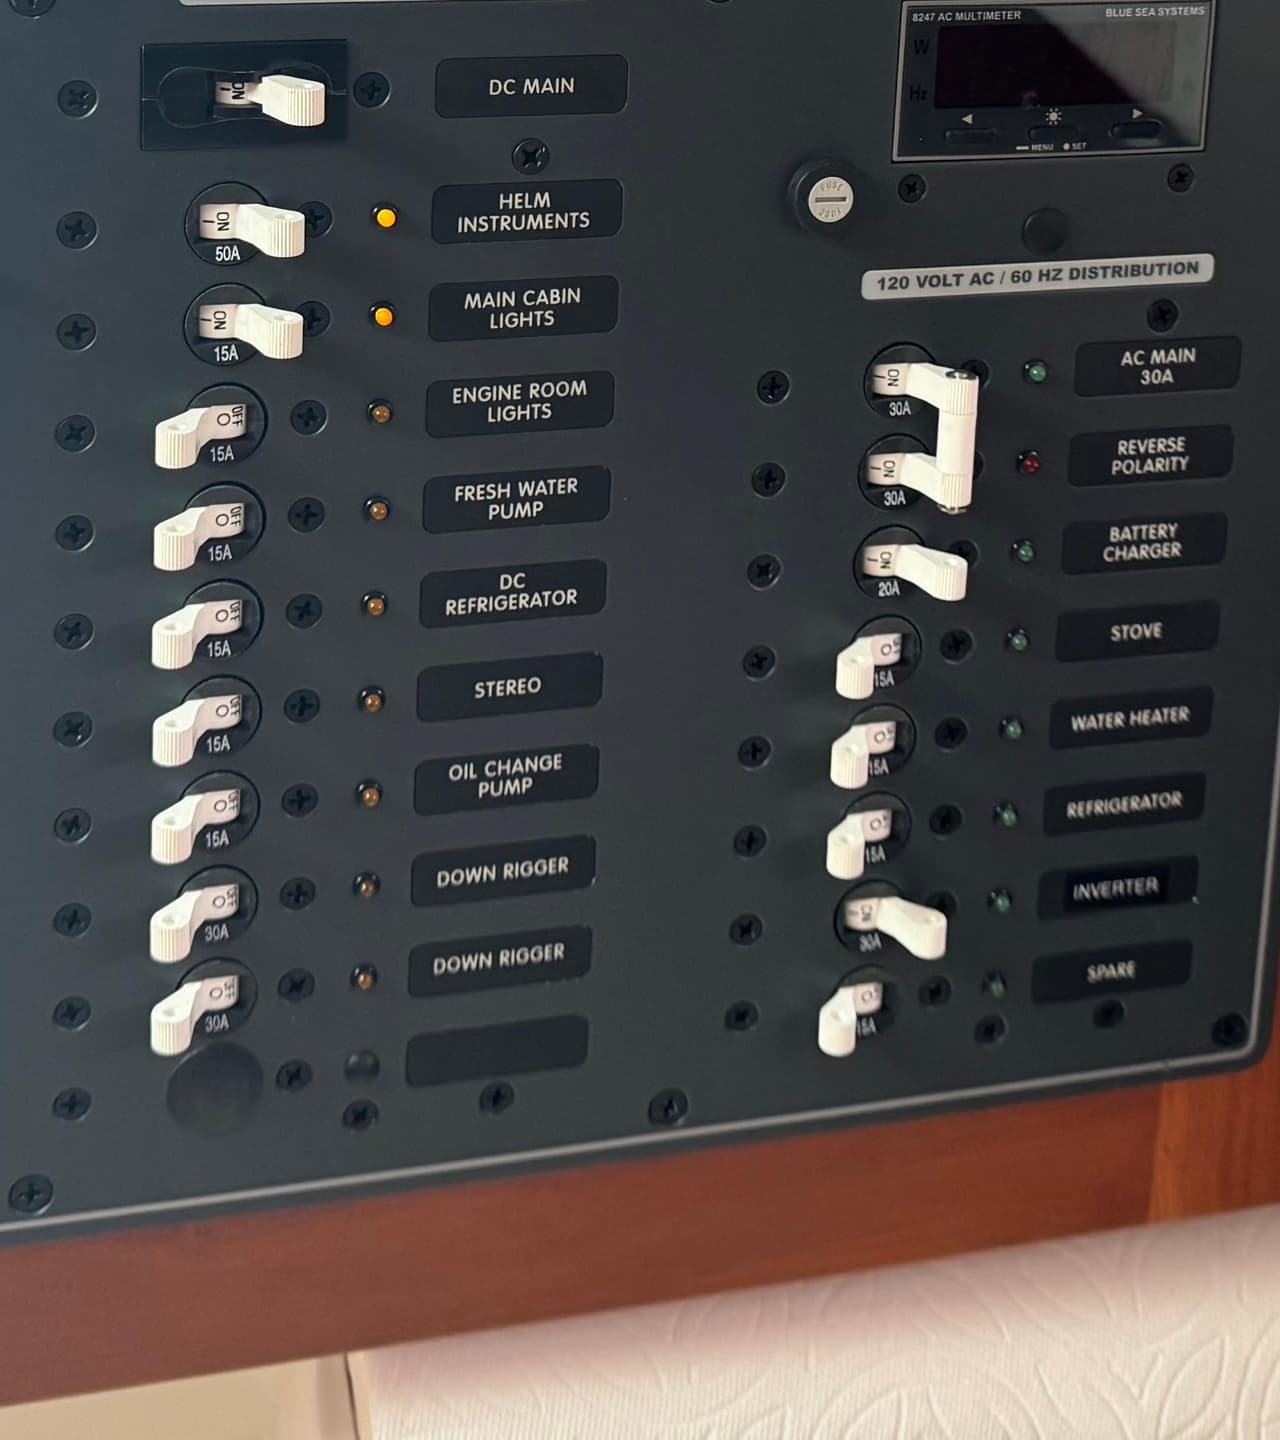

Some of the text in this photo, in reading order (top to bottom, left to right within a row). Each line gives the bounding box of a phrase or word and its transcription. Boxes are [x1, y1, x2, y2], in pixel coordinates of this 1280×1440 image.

[912, 10, 1021, 23] 8247 AC MULTIMETER
[1106, 7, 1205, 18] BLUE SEA SYSTEMS
[489, 78, 575, 96] DC MAIN
[499, 193, 551, 209] HELM
[458, 212, 590, 233] INSTRUMENTS
[215, 245, 240, 261] 50A
[877, 262, 1199, 291] 120 VOLT AC 60 HZ DISTRIBUTION
[464, 288, 581, 310] MAIN CABIN
[490, 310, 554, 329] LIGHTS
[1121, 348, 1196, 366] AC MAIN
[1140, 369, 1174, 385] 30A
[452, 380, 587, 405] ENGINE ROOM
[487, 403, 552, 423] LIGHTS
[889, 402, 911, 416] 30A
[1118, 437, 1186, 456] REVERSE
[1112, 456, 1189, 475] POLARITY
[455, 478, 578, 502] FRESH WATER
[489, 502, 543, 521] PUMP
[1110, 523, 1178, 542] BATTERY
[1103, 542, 1182, 562] CHARGER
[500, 573, 525, 590] DC
[446, 590, 578, 617] REFRIGERATOR
[1111, 623, 1162, 640] STOVE
[474, 678, 541, 699] STEREO
[1071, 706, 1191, 732] WATER HEATER
[449, 754, 562, 782] OIL CHANGE
[478, 778, 533, 799] PUMP
[1067, 791, 1183, 818] REFRIGERATOR
[437, 857, 569, 888] DOWN RIGGER
[1073, 876, 1160, 900] INVERTER
[433, 943, 565, 975] DOWN RIGGER
[1088, 961, 1136, 982] SPARE
